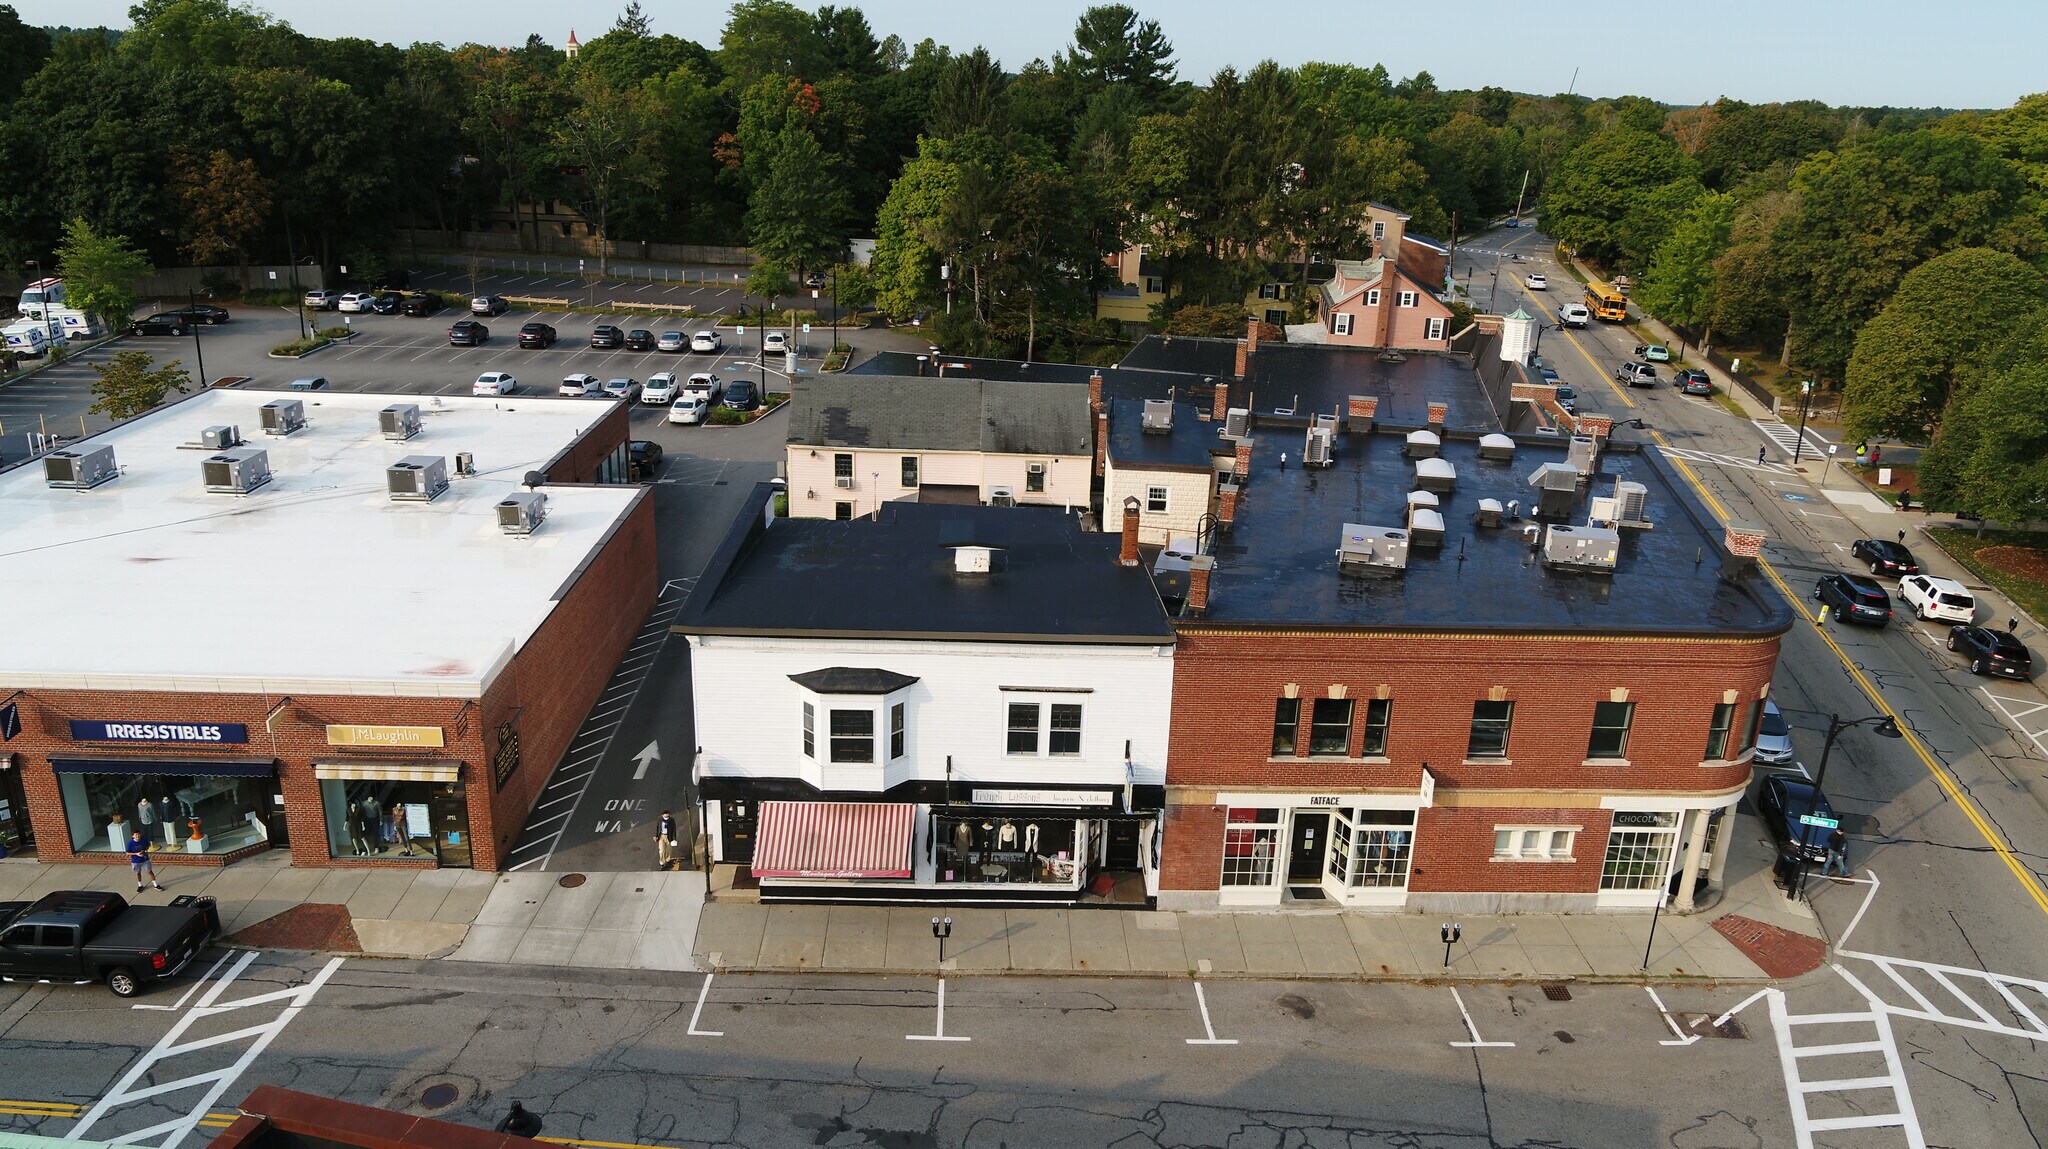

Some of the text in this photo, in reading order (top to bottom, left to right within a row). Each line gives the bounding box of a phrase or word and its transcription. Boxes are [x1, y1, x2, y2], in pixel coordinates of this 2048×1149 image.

[105, 724, 222, 741] IRRESISTIBLES
[352, 728, 420, 743] J.McLaughlin
[604, 799, 646, 811] ONE
[1310, 796, 1340, 806] FATFACE
[594, 820, 640, 833] WAY
